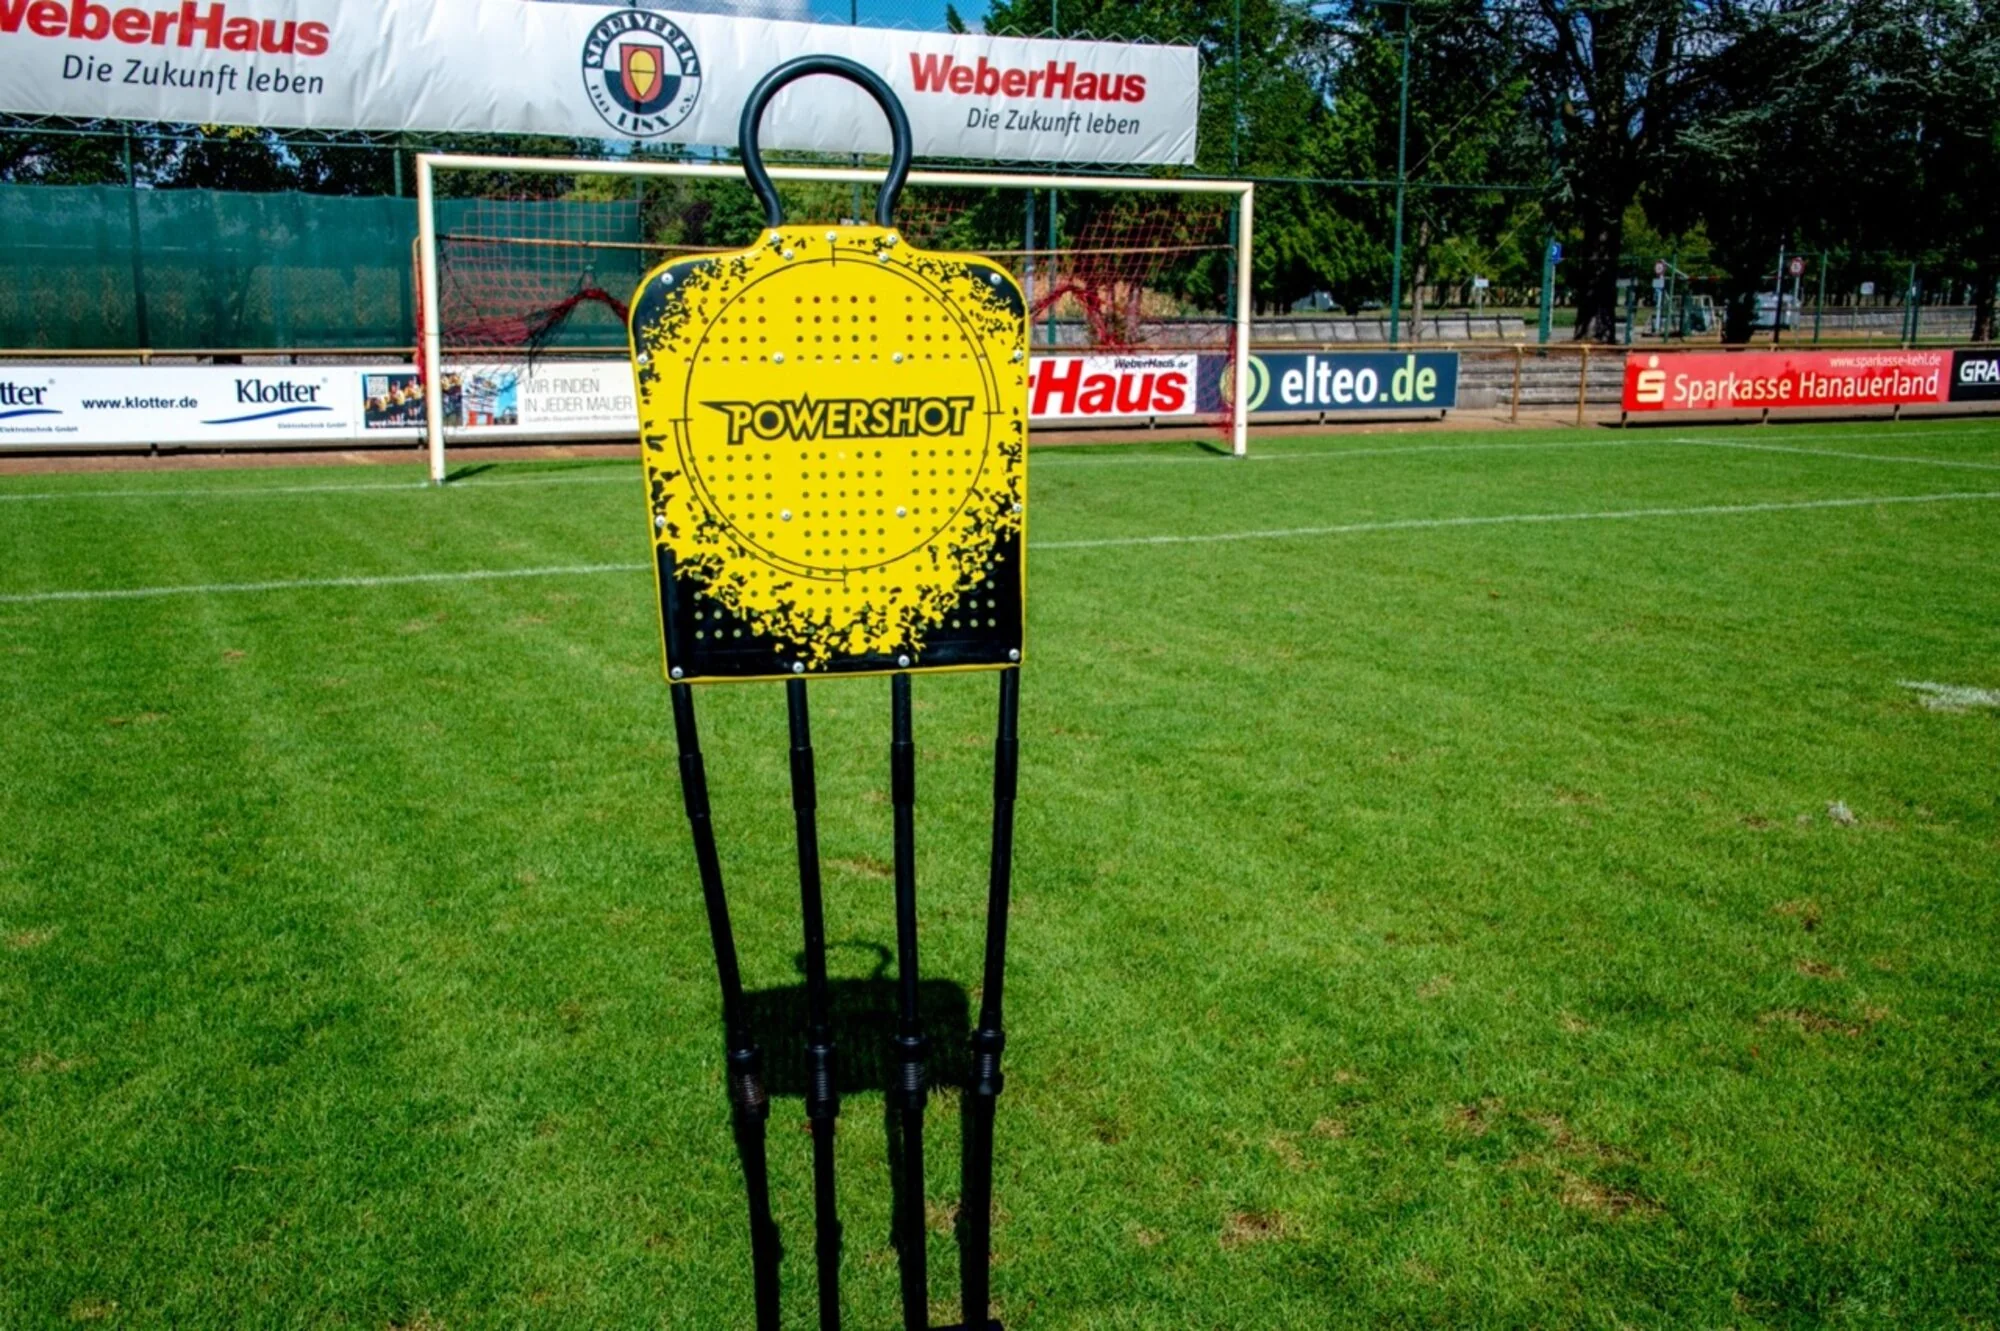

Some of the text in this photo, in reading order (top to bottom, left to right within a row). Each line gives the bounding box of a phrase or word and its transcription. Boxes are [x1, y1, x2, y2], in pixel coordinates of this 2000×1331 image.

[62, 54, 324, 95] Die Zukunft leben
[909, 52, 1147, 103] WeberHaus
[966, 107, 1140, 137] Die Zukunft leben
[1830, 353, 1942, 369] www.sparkasse-kehl.de
[234, 378, 321, 403] Klotter
[523, 378, 600, 394] WIR FINDEN
[1280, 354, 1438, 405] elteo.de
[1672, 369, 1940, 409] Sparkasse Hanauerland
[82, 396, 198, 409] www.klotter.de
[525, 395, 633, 412] IN JEDER MAUER
[698, 391, 975, 446] POWERSHOT
